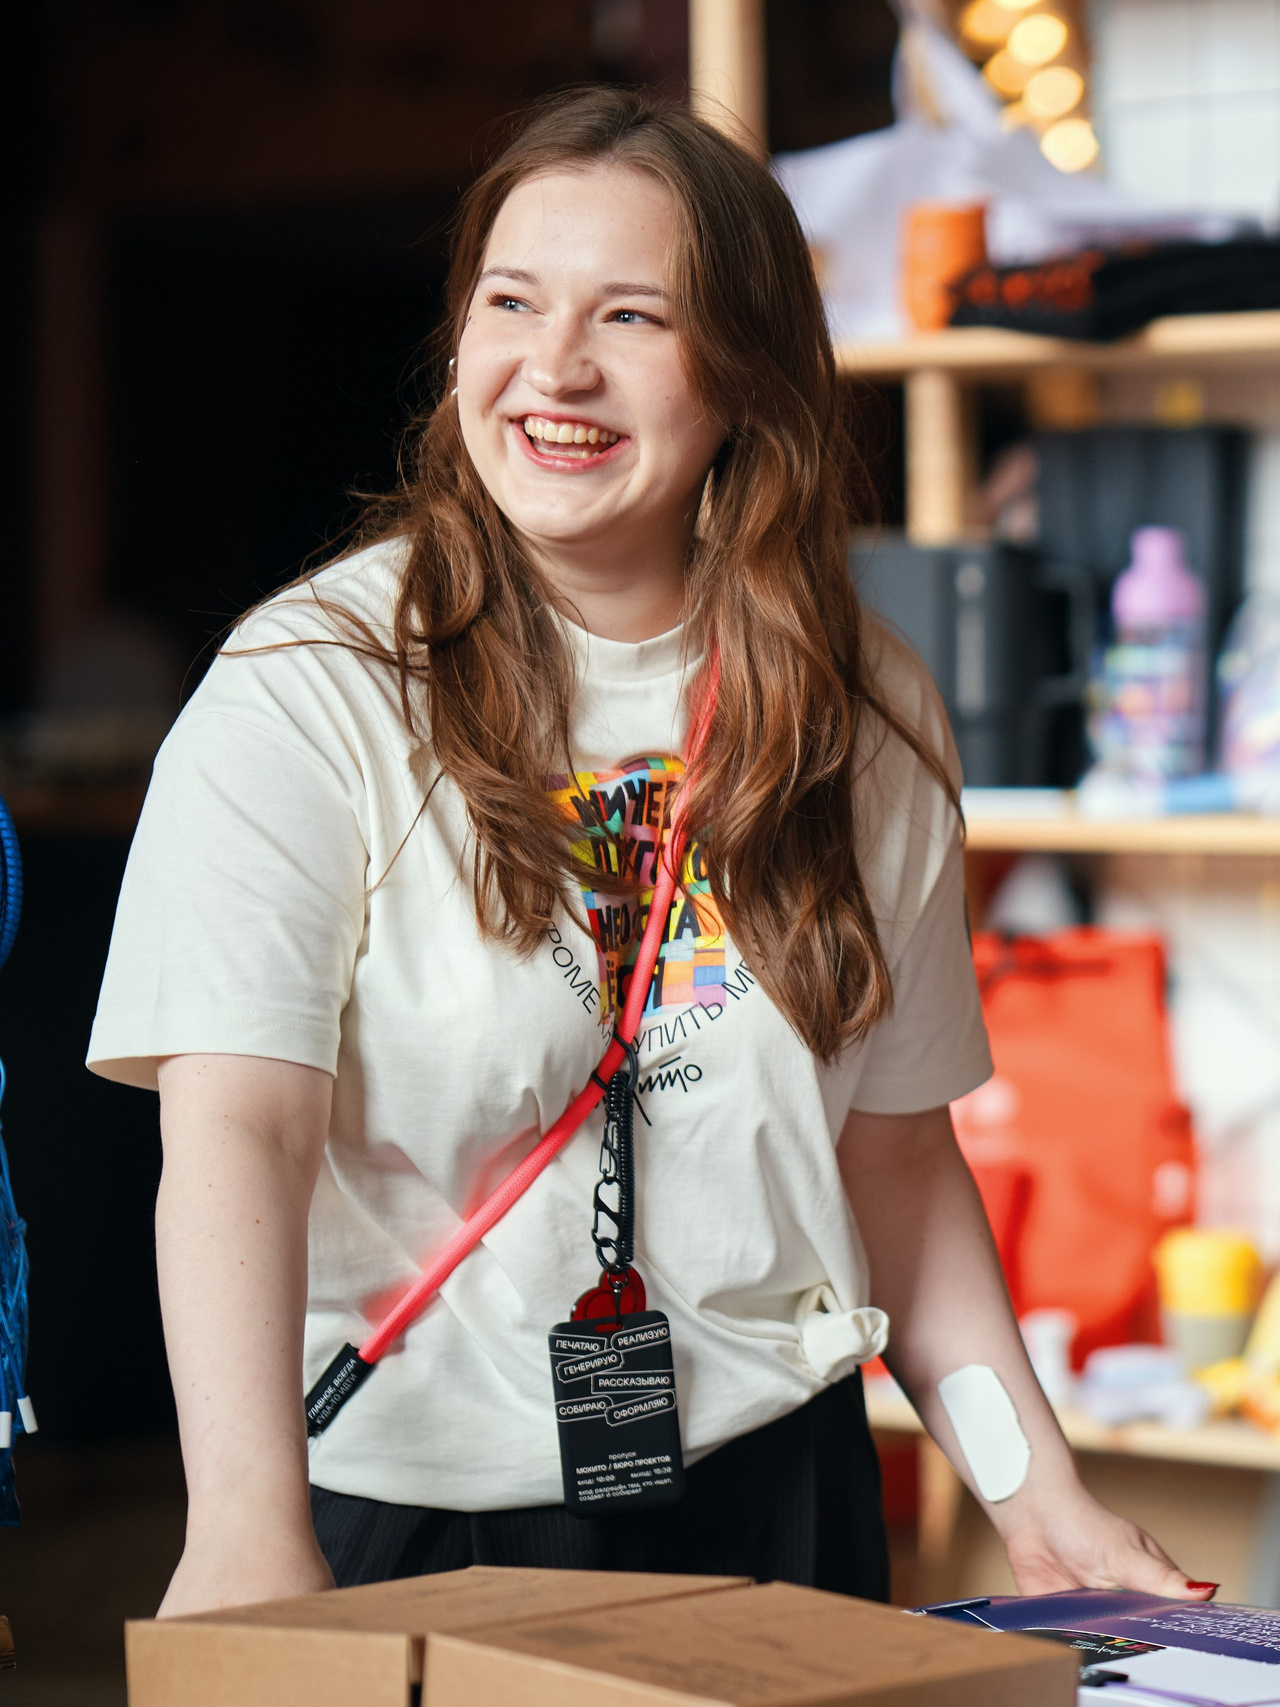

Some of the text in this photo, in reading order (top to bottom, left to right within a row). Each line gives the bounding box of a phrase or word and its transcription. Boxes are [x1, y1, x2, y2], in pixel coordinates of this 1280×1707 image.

[547, 921, 600, 1014] РОМЕ
[633, 1001, 723, 1054] УПИТЬ
[555, 1339, 600, 1351] ПЕЧАТАЮ
[617, 1327, 668, 1347] РЕАЛИЗУЮ
[563, 1354, 618, 1376] ГЕНЕРИРУЮ
[598, 1376, 670, 1387] РАССКАЗЫВАЮ
[307, 1385, 336, 1420] ГЛАВНОЕ,
[315, 1373, 358, 1425] КУДА-ТО ИДТИ
[559, 1401, 606, 1416] СОБИРАЮ
[613, 1397, 668, 1420] ОФОРМЛЯЮ
[575, 1464, 607, 1475] МОХИТО
[613, 1460, 634, 1470] БЮРО
[635, 1455, 671, 1467] ПРОЕКТОВ
[608, 1451, 637, 1460] пропуск
